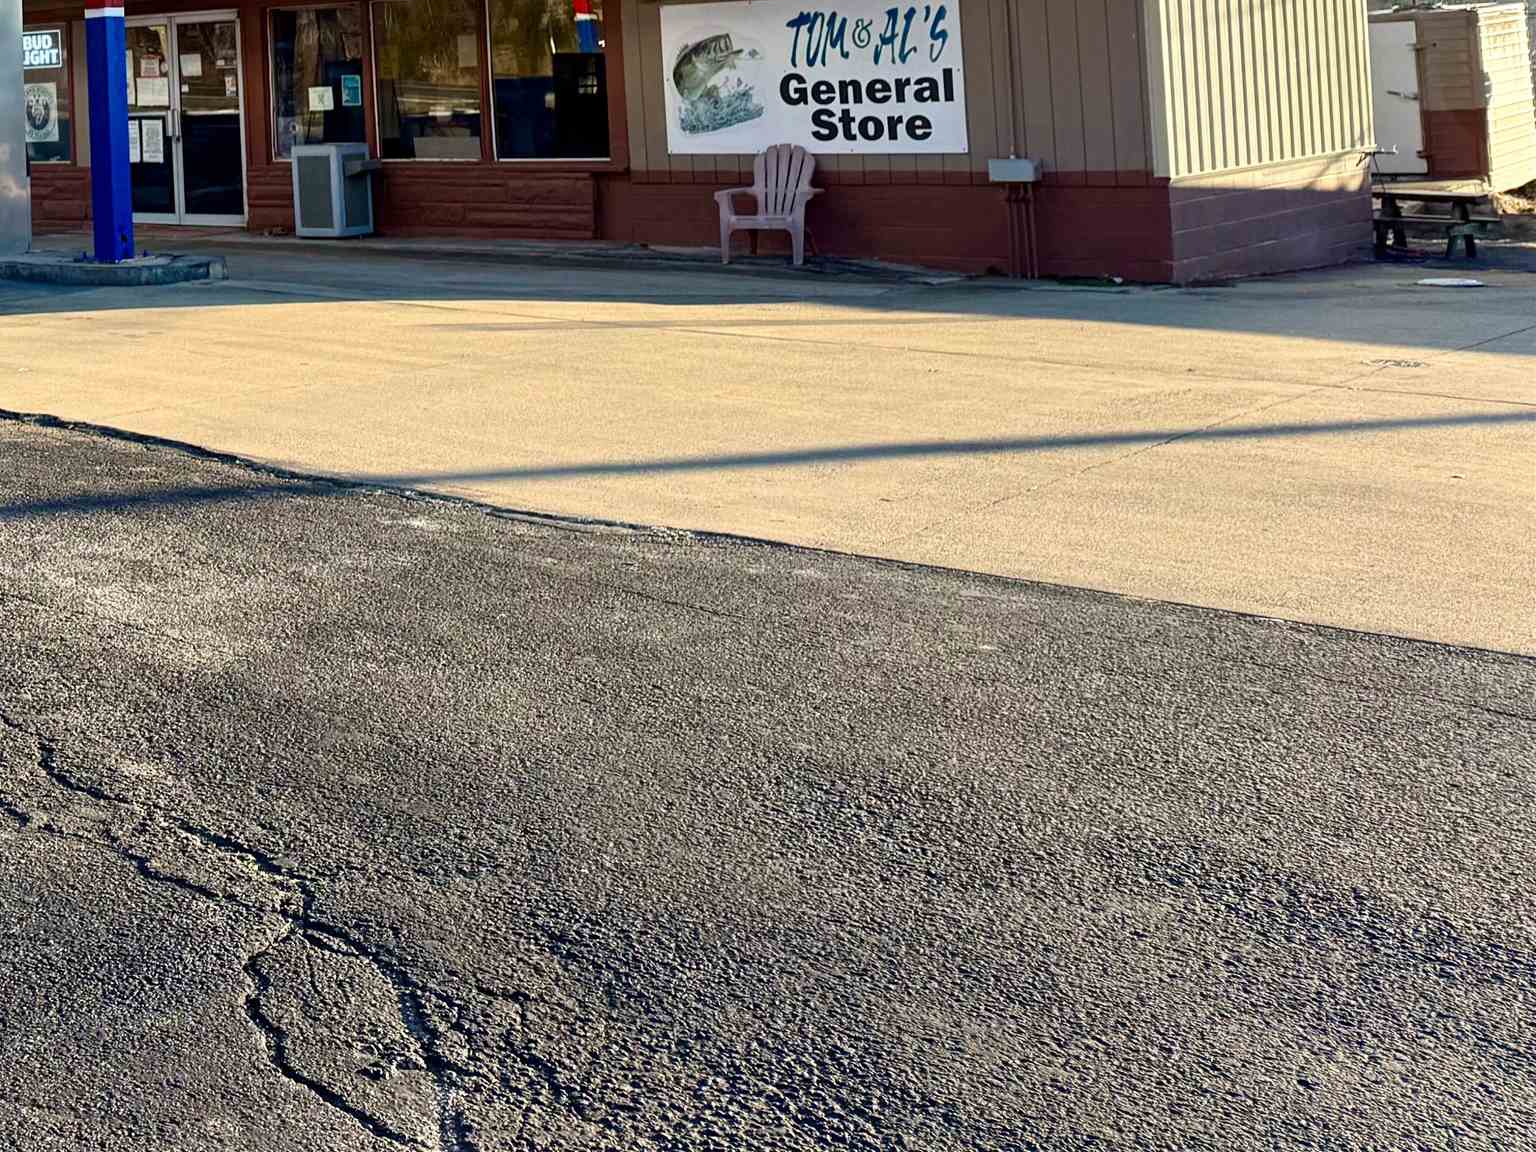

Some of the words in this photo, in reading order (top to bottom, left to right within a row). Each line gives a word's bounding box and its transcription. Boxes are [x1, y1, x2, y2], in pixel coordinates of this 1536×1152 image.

[23, 34, 53, 50] BUD
[786, 11, 850, 67] TOM
[852, 17, 873, 48] &
[23, 48, 58, 66] IGHT
[779, 67, 955, 106] General
[810, 108, 933, 141] Store
